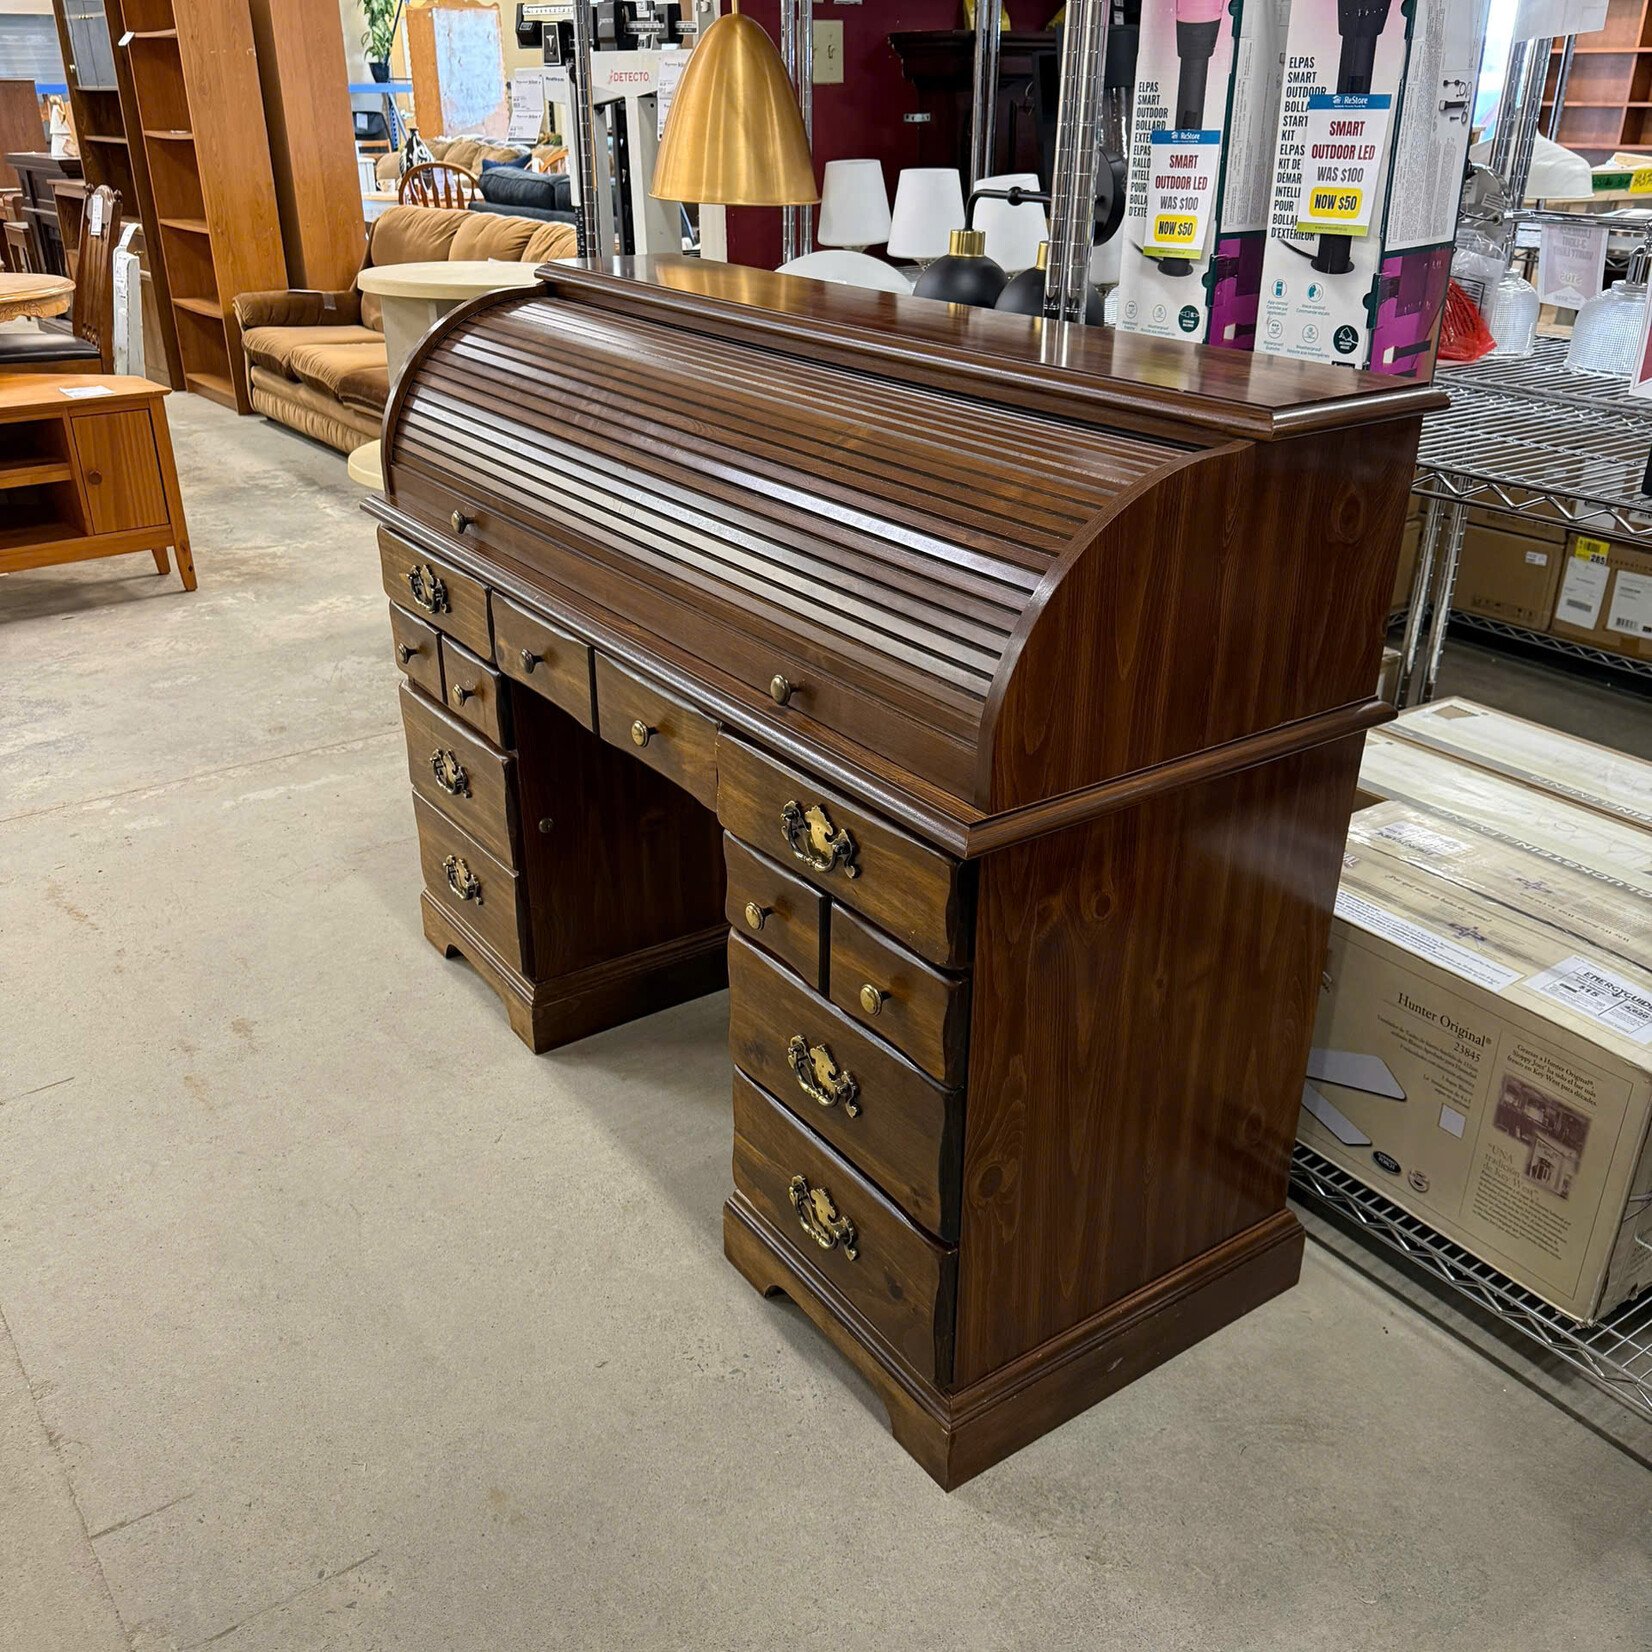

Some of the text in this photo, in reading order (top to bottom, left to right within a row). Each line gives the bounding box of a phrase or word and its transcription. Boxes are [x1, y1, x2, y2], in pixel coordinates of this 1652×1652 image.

[1289, 57, 1315, 68] ELPAS
[613, 71, 650, 82] DETECTO
[1288, 72, 1317, 83] SMART
[1138, 82, 1159, 92] ELPAS
[1286, 87, 1327, 98] OUTDOOR
[1137, 94, 1160, 105] SMART
[1344, 96, 1369, 104] ReStore
[1136, 107, 1168, 118] OUTDOOR
[1135, 120, 1166, 131] BOLLARD
[1283, 116, 1308, 127] START
[1329, 121, 1365, 136] SMART
[1180, 131, 1200, 140] ReStore
[1281, 130, 1295, 141] KIT
[1133, 145, 1151, 156] ELPAS
[1280, 144, 1305, 156] ELPAS
[1311, 144, 1376, 160] OUTDOOR LED
[1132, 157, 1151, 169] RALLO
[1169, 155, 1199, 169] SMART
[1278, 158, 1301, 170] KIT DE
[1131, 170, 1150, 181] INTELL
[1276, 169, 1302, 184] DÉMAR
[1317, 166, 1364, 183] WAS $100
[1130, 182, 1147, 193] POUR
[1155, 175, 1208, 190] OUTDOOR LED
[1275, 186, 1301, 198] INTELLI
[1129, 194, 1148, 206] BOLLA
[1160, 196, 1199, 212] WAS $100
[1273, 200, 1294, 211] POUR
[1314, 194, 1357, 211] NOW $50
[1272, 213, 1298, 226] BOLLA
[1158, 220, 1193, 236] NOW $50
[1583, 971, 1652, 1010] ENERGYGUID
[1397, 991, 1438, 1021] Hunter
[1453, 1041, 1481, 1062] 23845
